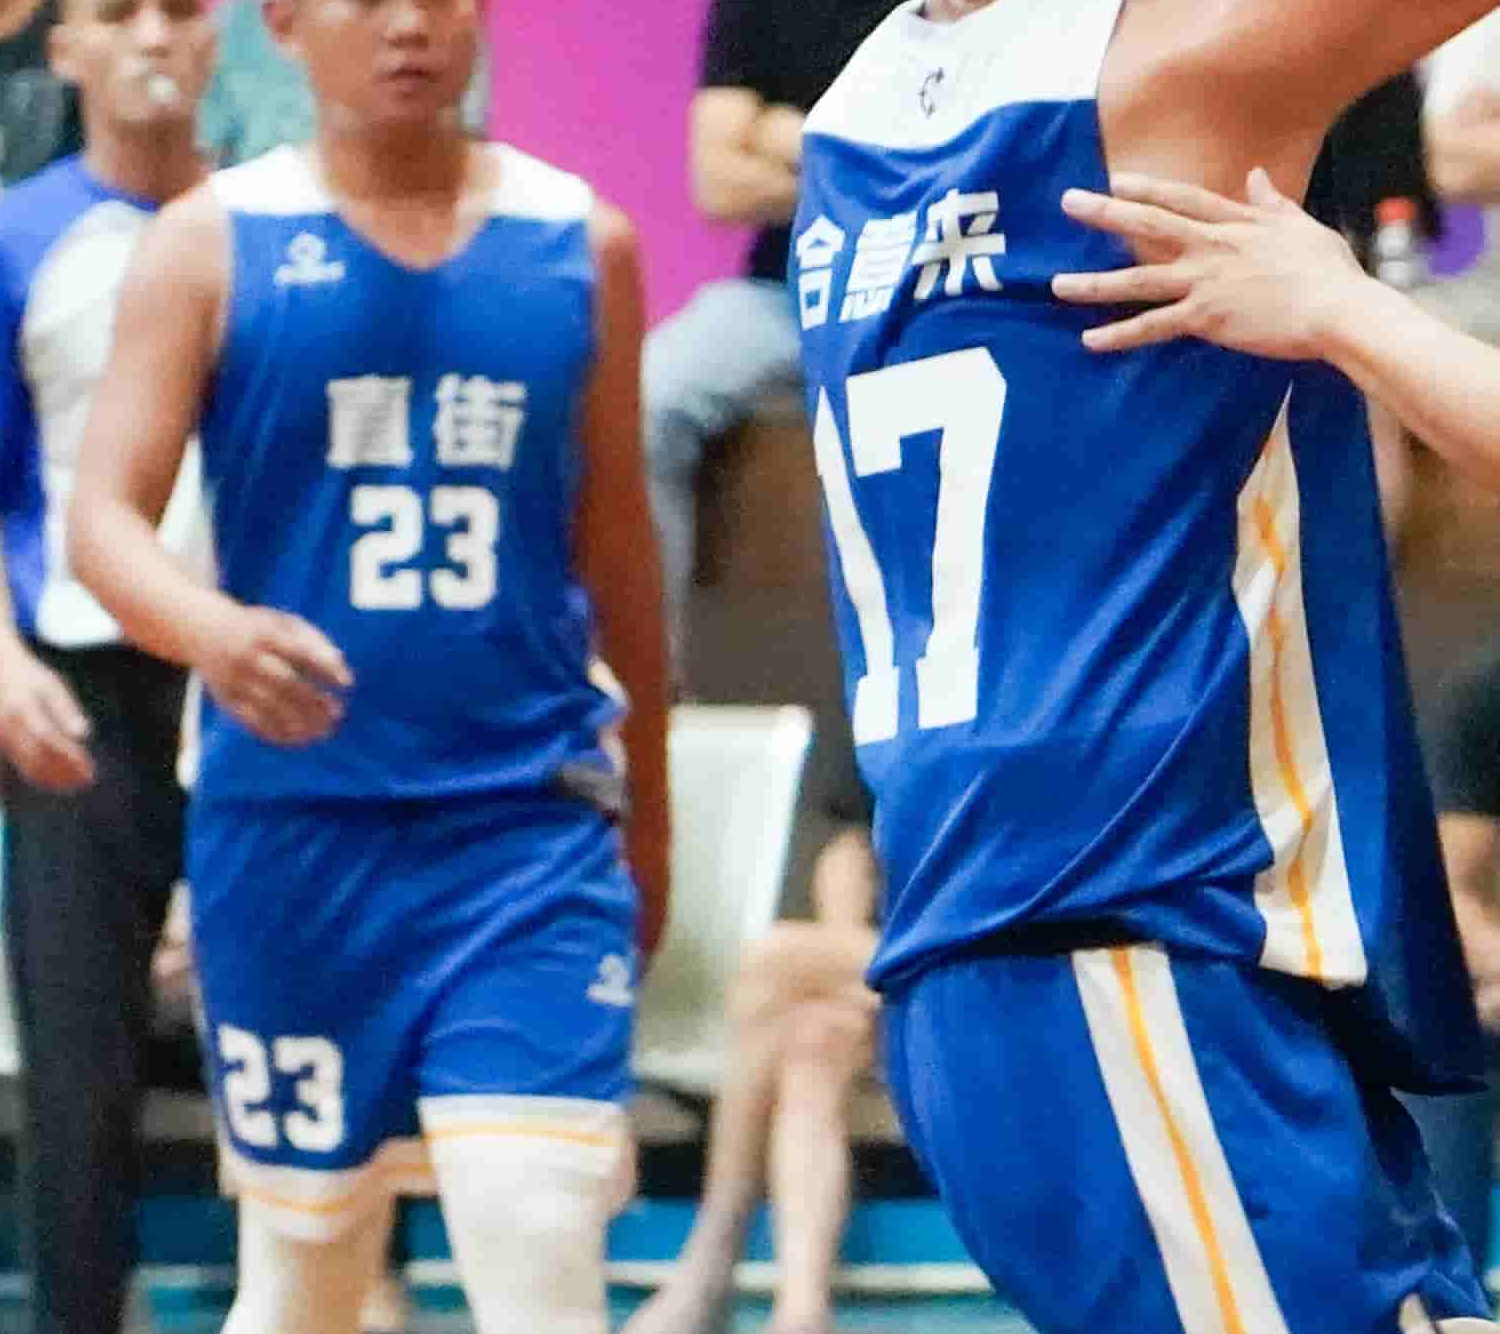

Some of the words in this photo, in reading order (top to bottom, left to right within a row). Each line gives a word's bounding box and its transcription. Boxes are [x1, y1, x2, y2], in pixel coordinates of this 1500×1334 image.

[348, 484, 499, 613] 23
[813, 345, 1008, 747] 17
[217, 1021, 345, 1154] 23
